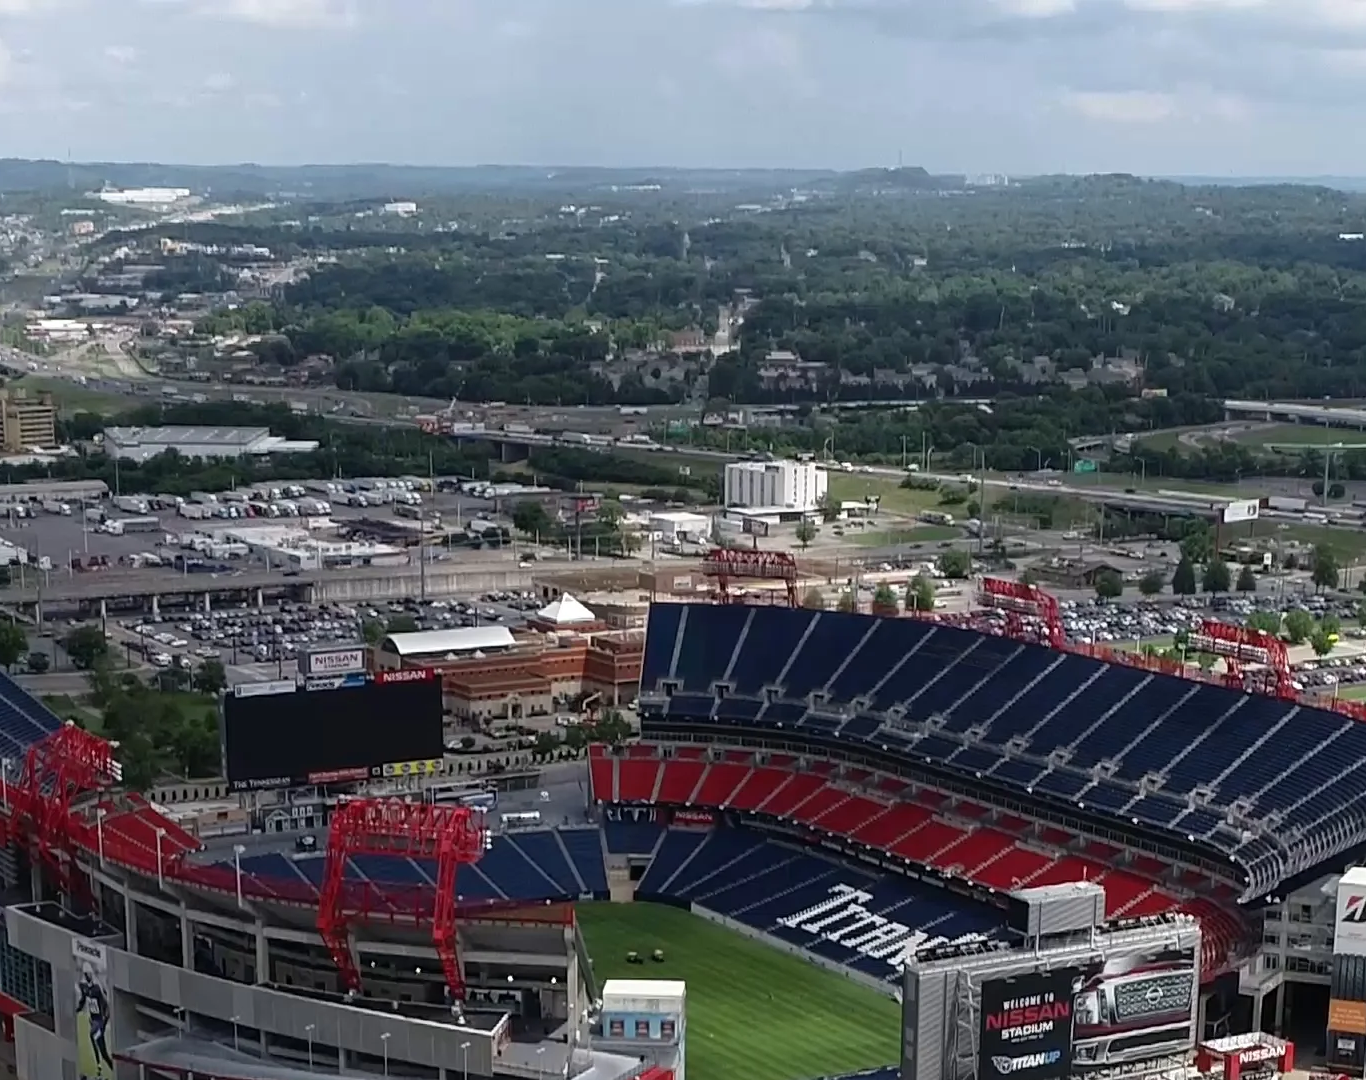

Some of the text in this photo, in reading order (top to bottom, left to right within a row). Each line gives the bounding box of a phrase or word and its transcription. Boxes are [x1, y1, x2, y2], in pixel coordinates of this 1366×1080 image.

[315, 653, 358, 665] NISSAN
[383, 669, 426, 682] NISSAN
[1003, 992, 1055, 1010] WELCOME TO
[985, 1001, 1070, 1031] NISSAN
[1001, 1020, 1053, 1040] STADIUM
[1240, 1045, 1286, 1064] NISSAN
